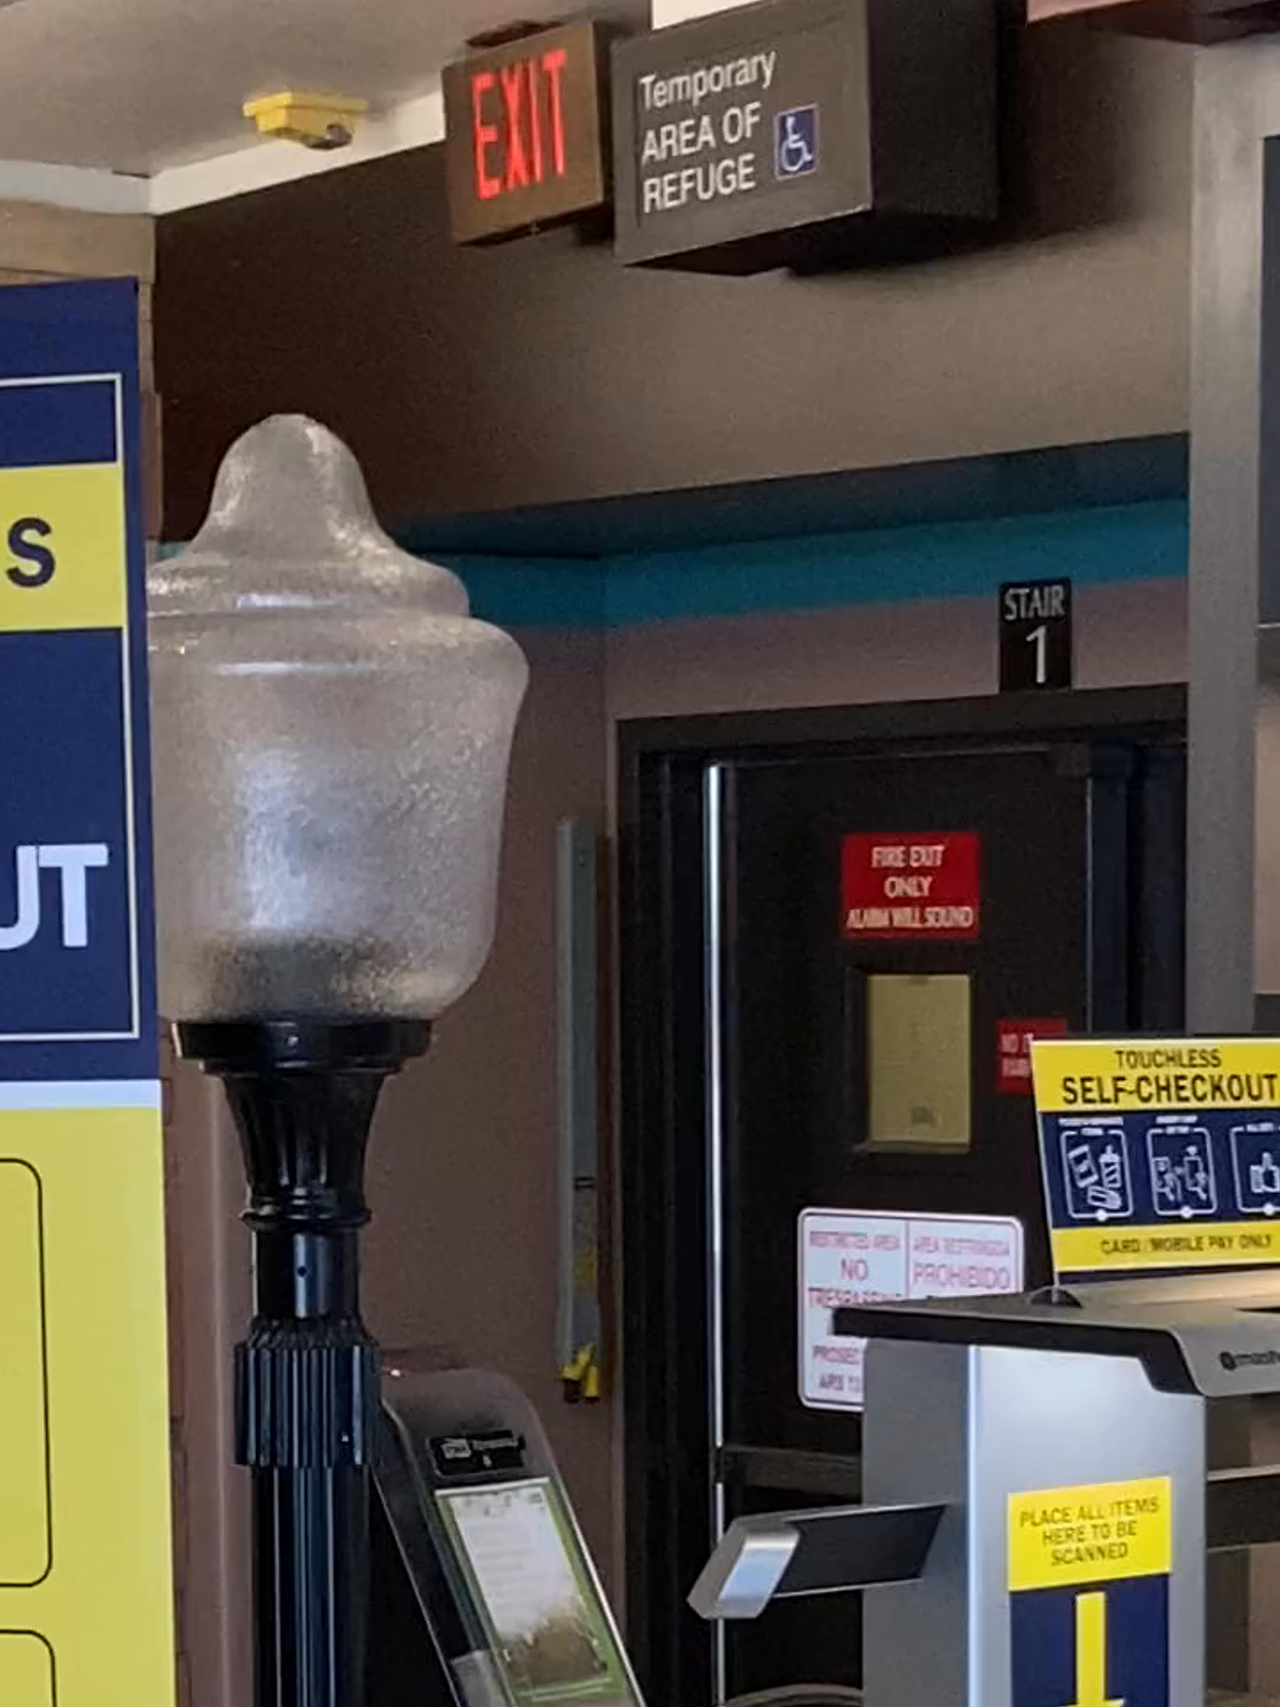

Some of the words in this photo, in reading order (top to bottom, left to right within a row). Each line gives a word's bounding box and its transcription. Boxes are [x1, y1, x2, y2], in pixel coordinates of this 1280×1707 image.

[639, 50, 776, 110] Temporary
[471, 48, 568, 201] EXIT
[642, 114, 716, 166] AREA
[722, 100, 762, 144] OF
[643, 152, 756, 214] REFUGE
[1004, 584, 1066, 622] STAIR
[1025, 624, 1046, 684] 1
[871, 845, 906, 868] FIRE
[909, 844, 945, 868] EXIT
[883, 875, 933, 898] ONLY
[846, 907, 890, 929] ALARM
[891, 906, 923, 929] WILL
[923, 905, 973, 928] SOUND
[1115, 1048, 1222, 1070] TOUCHLESS
[1062, 1073, 1278, 1105] SELF-CHECKOUT
[1208, 1235, 1235, 1250] PAY
[1238, 1233, 1272, 1250] ONLY
[840, 1258, 869, 1281] NO
[1020, 1506, 1072, 1529] PLACE
[1077, 1502, 1105, 1523] ALL
[1109, 1496, 1160, 1518] ITEMS
[1042, 1523, 1086, 1546] HERE
[1090, 1522, 1112, 1542] TO
[1116, 1520, 1138, 1539] BE
[1050, 1542, 1129, 1566] SCANNED
